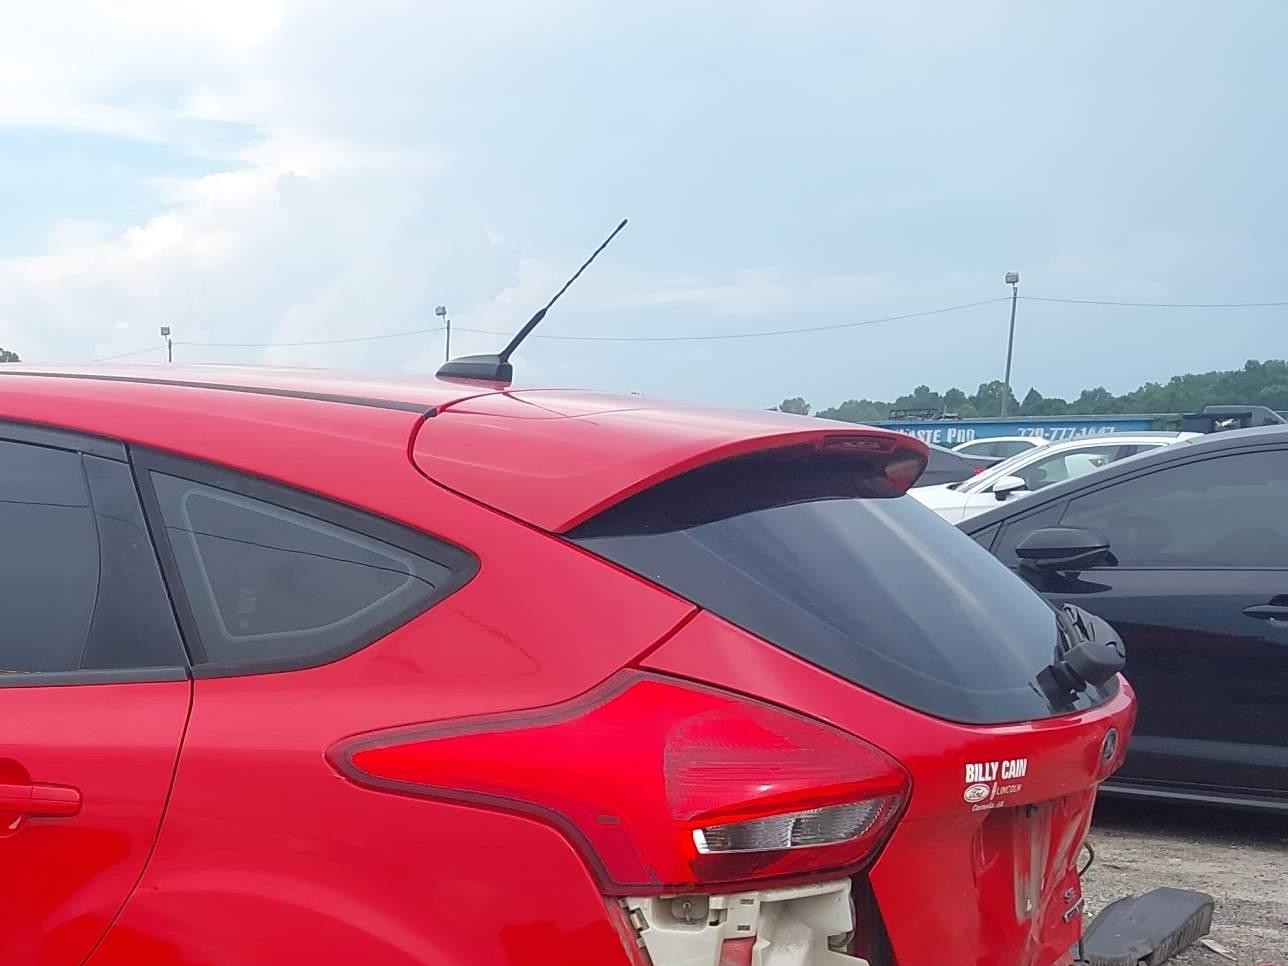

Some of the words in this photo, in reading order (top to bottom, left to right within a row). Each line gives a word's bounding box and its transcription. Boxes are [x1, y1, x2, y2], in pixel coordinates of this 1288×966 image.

[965, 761, 999, 783] BILLY
[1001, 758, 1028, 780] CAIN
[996, 784, 1022, 796] LINCOLN
